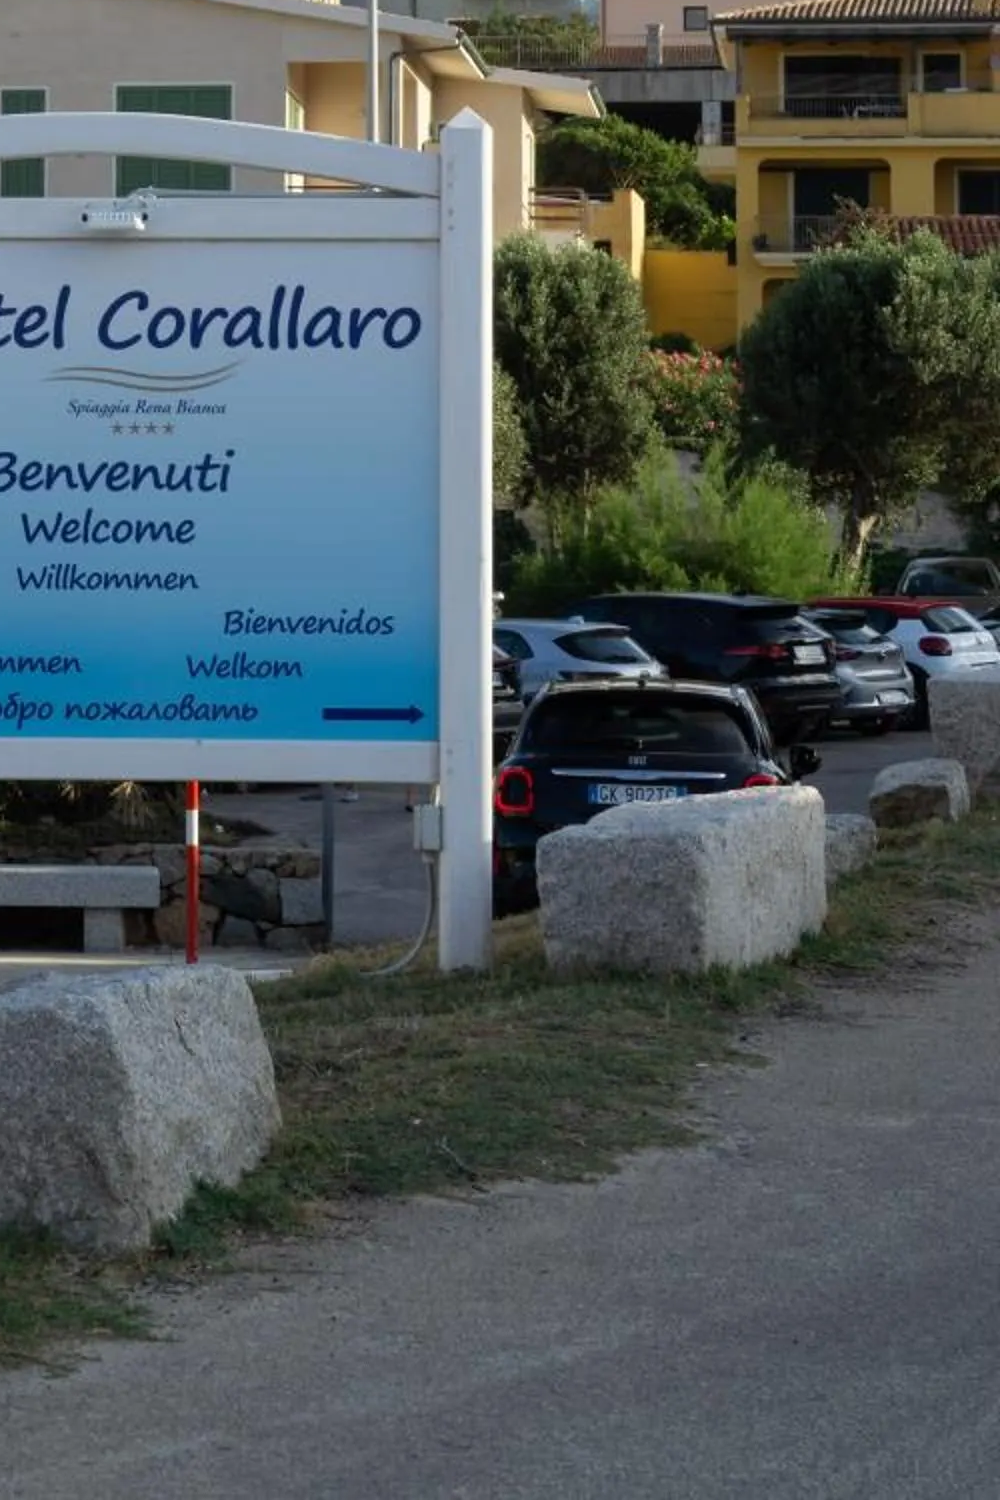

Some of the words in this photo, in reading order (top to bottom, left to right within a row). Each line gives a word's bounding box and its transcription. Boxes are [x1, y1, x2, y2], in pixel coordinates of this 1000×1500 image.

[98, 284, 422, 351] Corallaro
[67, 400, 131, 417] Spiaggia
[135, 399, 171, 414] Rena
[176, 399, 227, 414] Bianca
[21, 509, 196, 545] Welcome
[17, 564, 199, 591] Willkommen
[223, 608, 394, 636] Bienvenidos
[187, 652, 302, 679] Welkom
[65, 694, 258, 721] пожаловать
